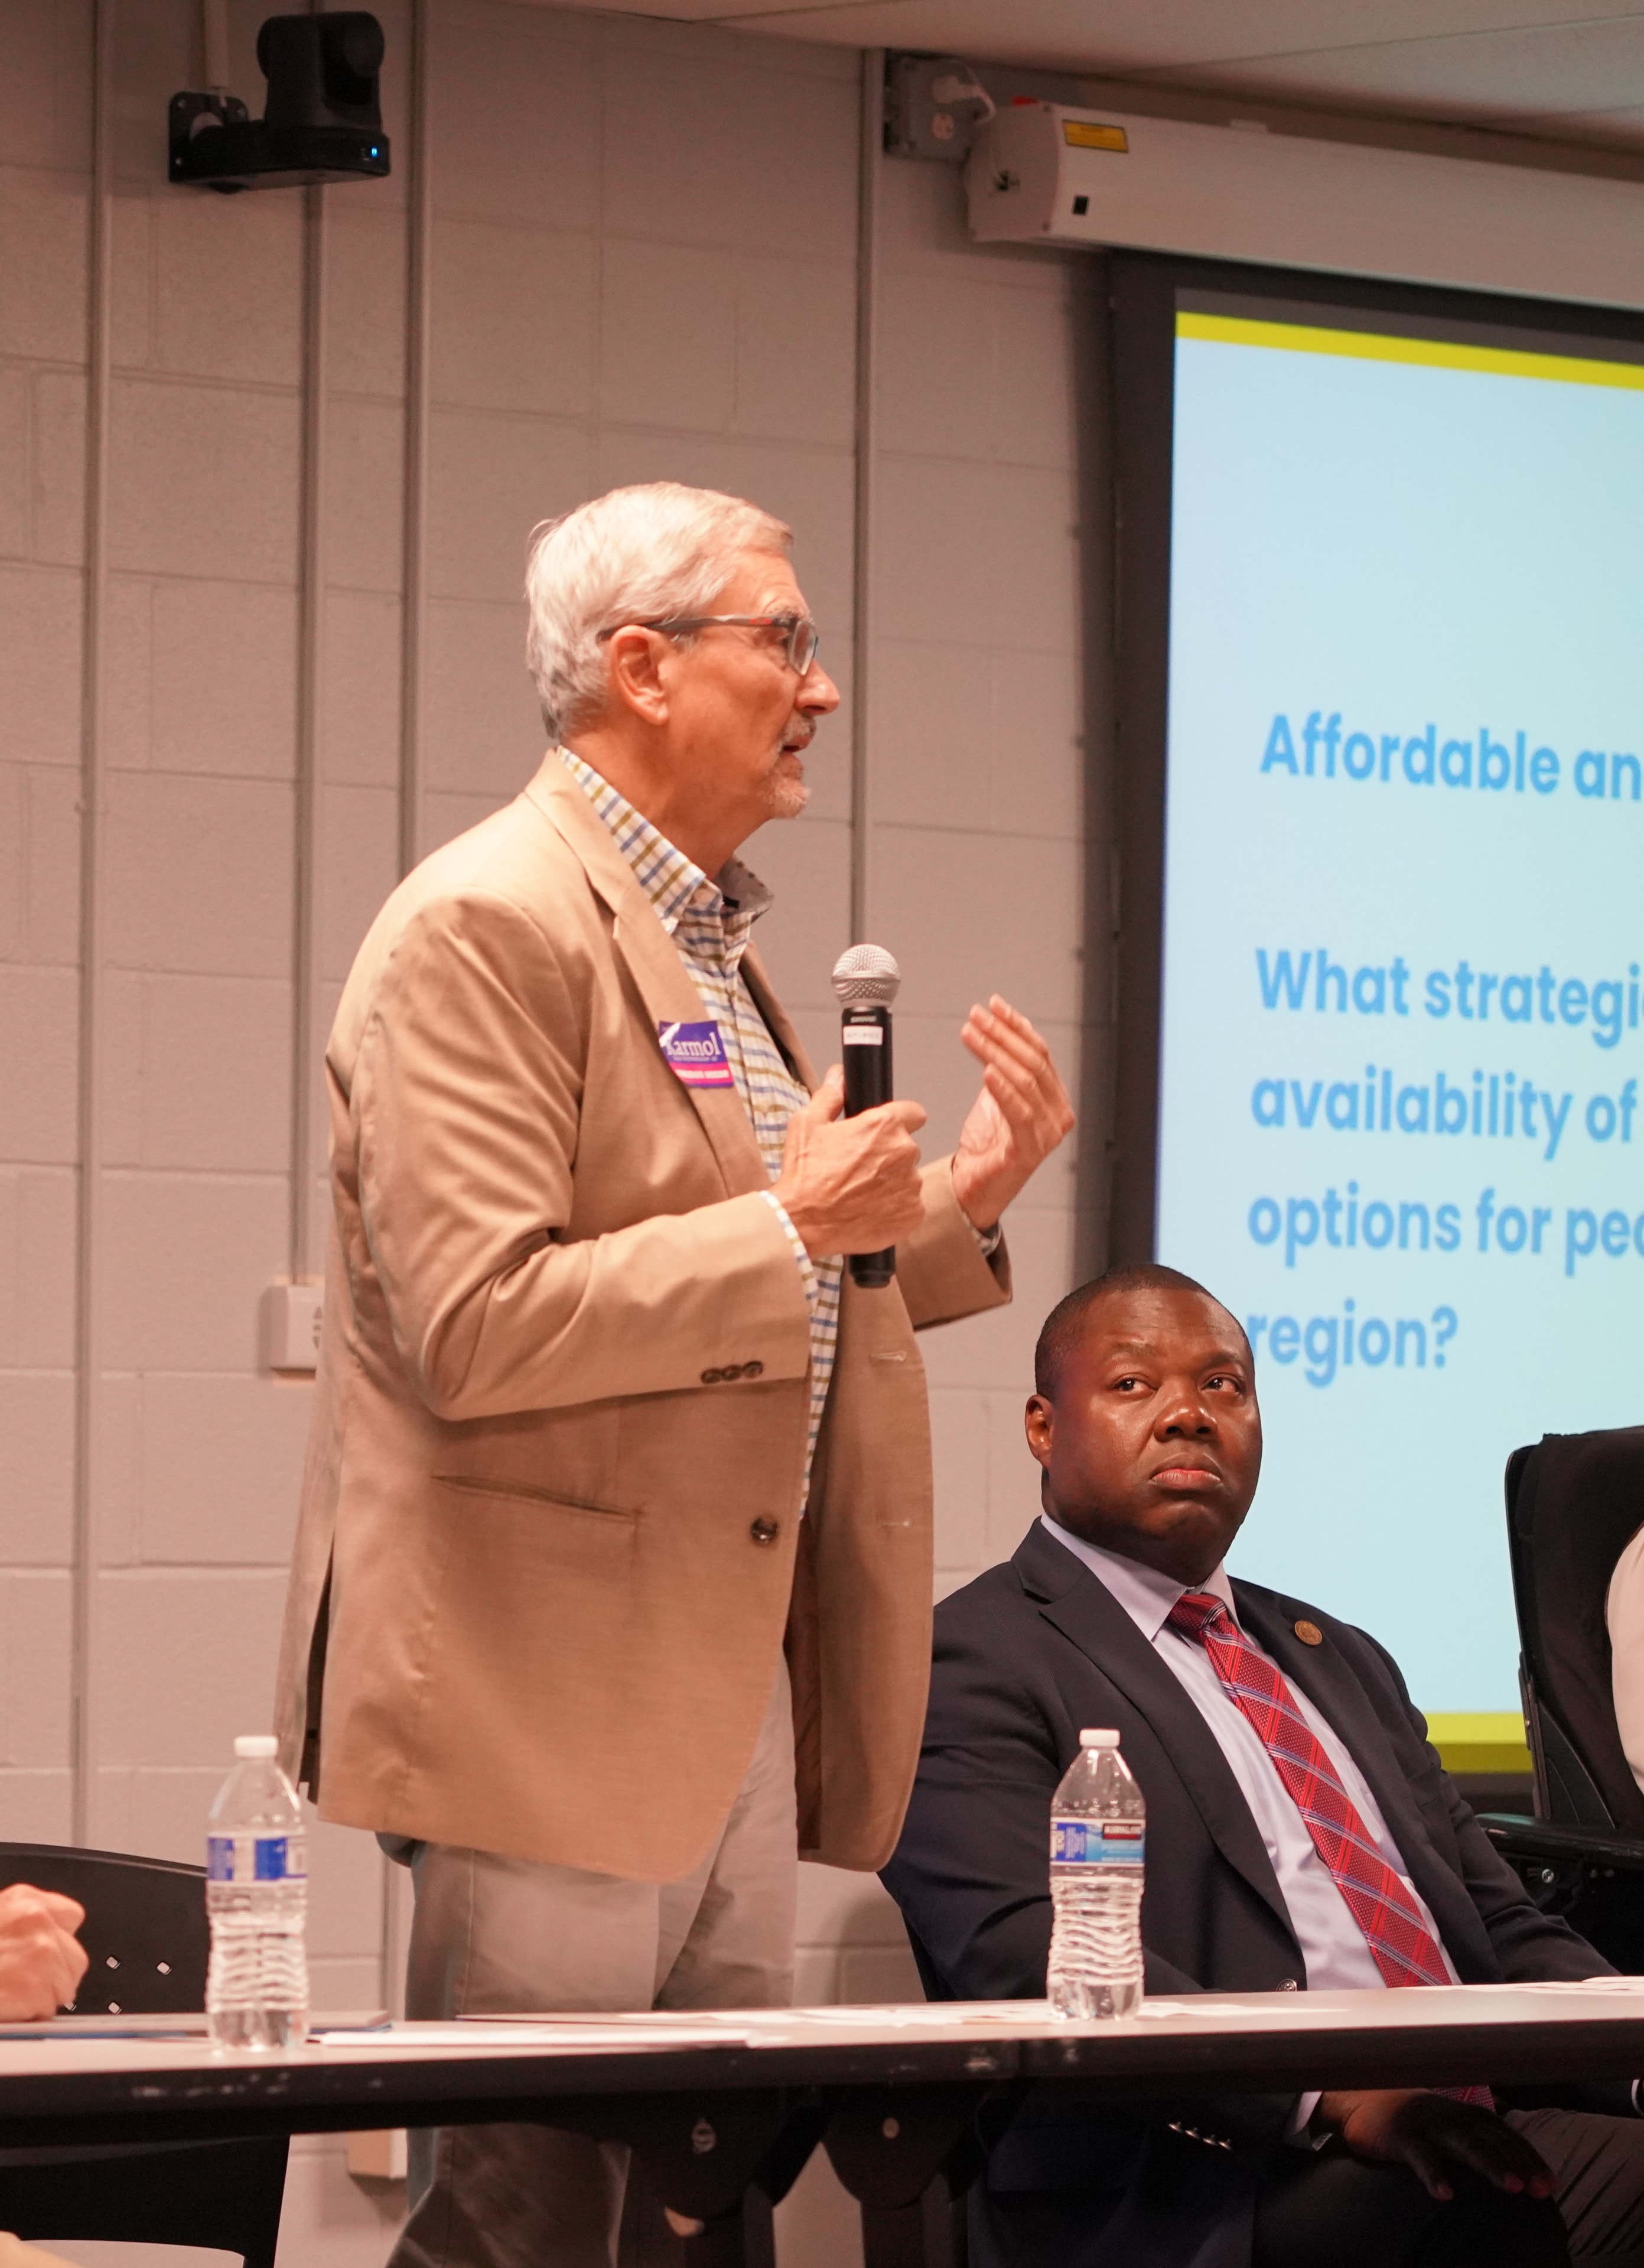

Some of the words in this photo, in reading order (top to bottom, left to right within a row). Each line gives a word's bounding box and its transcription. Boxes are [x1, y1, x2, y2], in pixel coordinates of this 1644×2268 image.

[1259, 710, 1562, 796] Affordable
[1573, 749, 1643, 802] an
[1255, 947, 1411, 1017] What
[1424, 960, 1644, 1051] strategi
[1251, 1063, 1574, 1162] availability
[1585, 1077, 1638, 1143] of
[1248, 1180, 1461, 1269] options
[1476, 1187, 1553, 1254] for
[1247, 1298, 1459, 1389] region?
